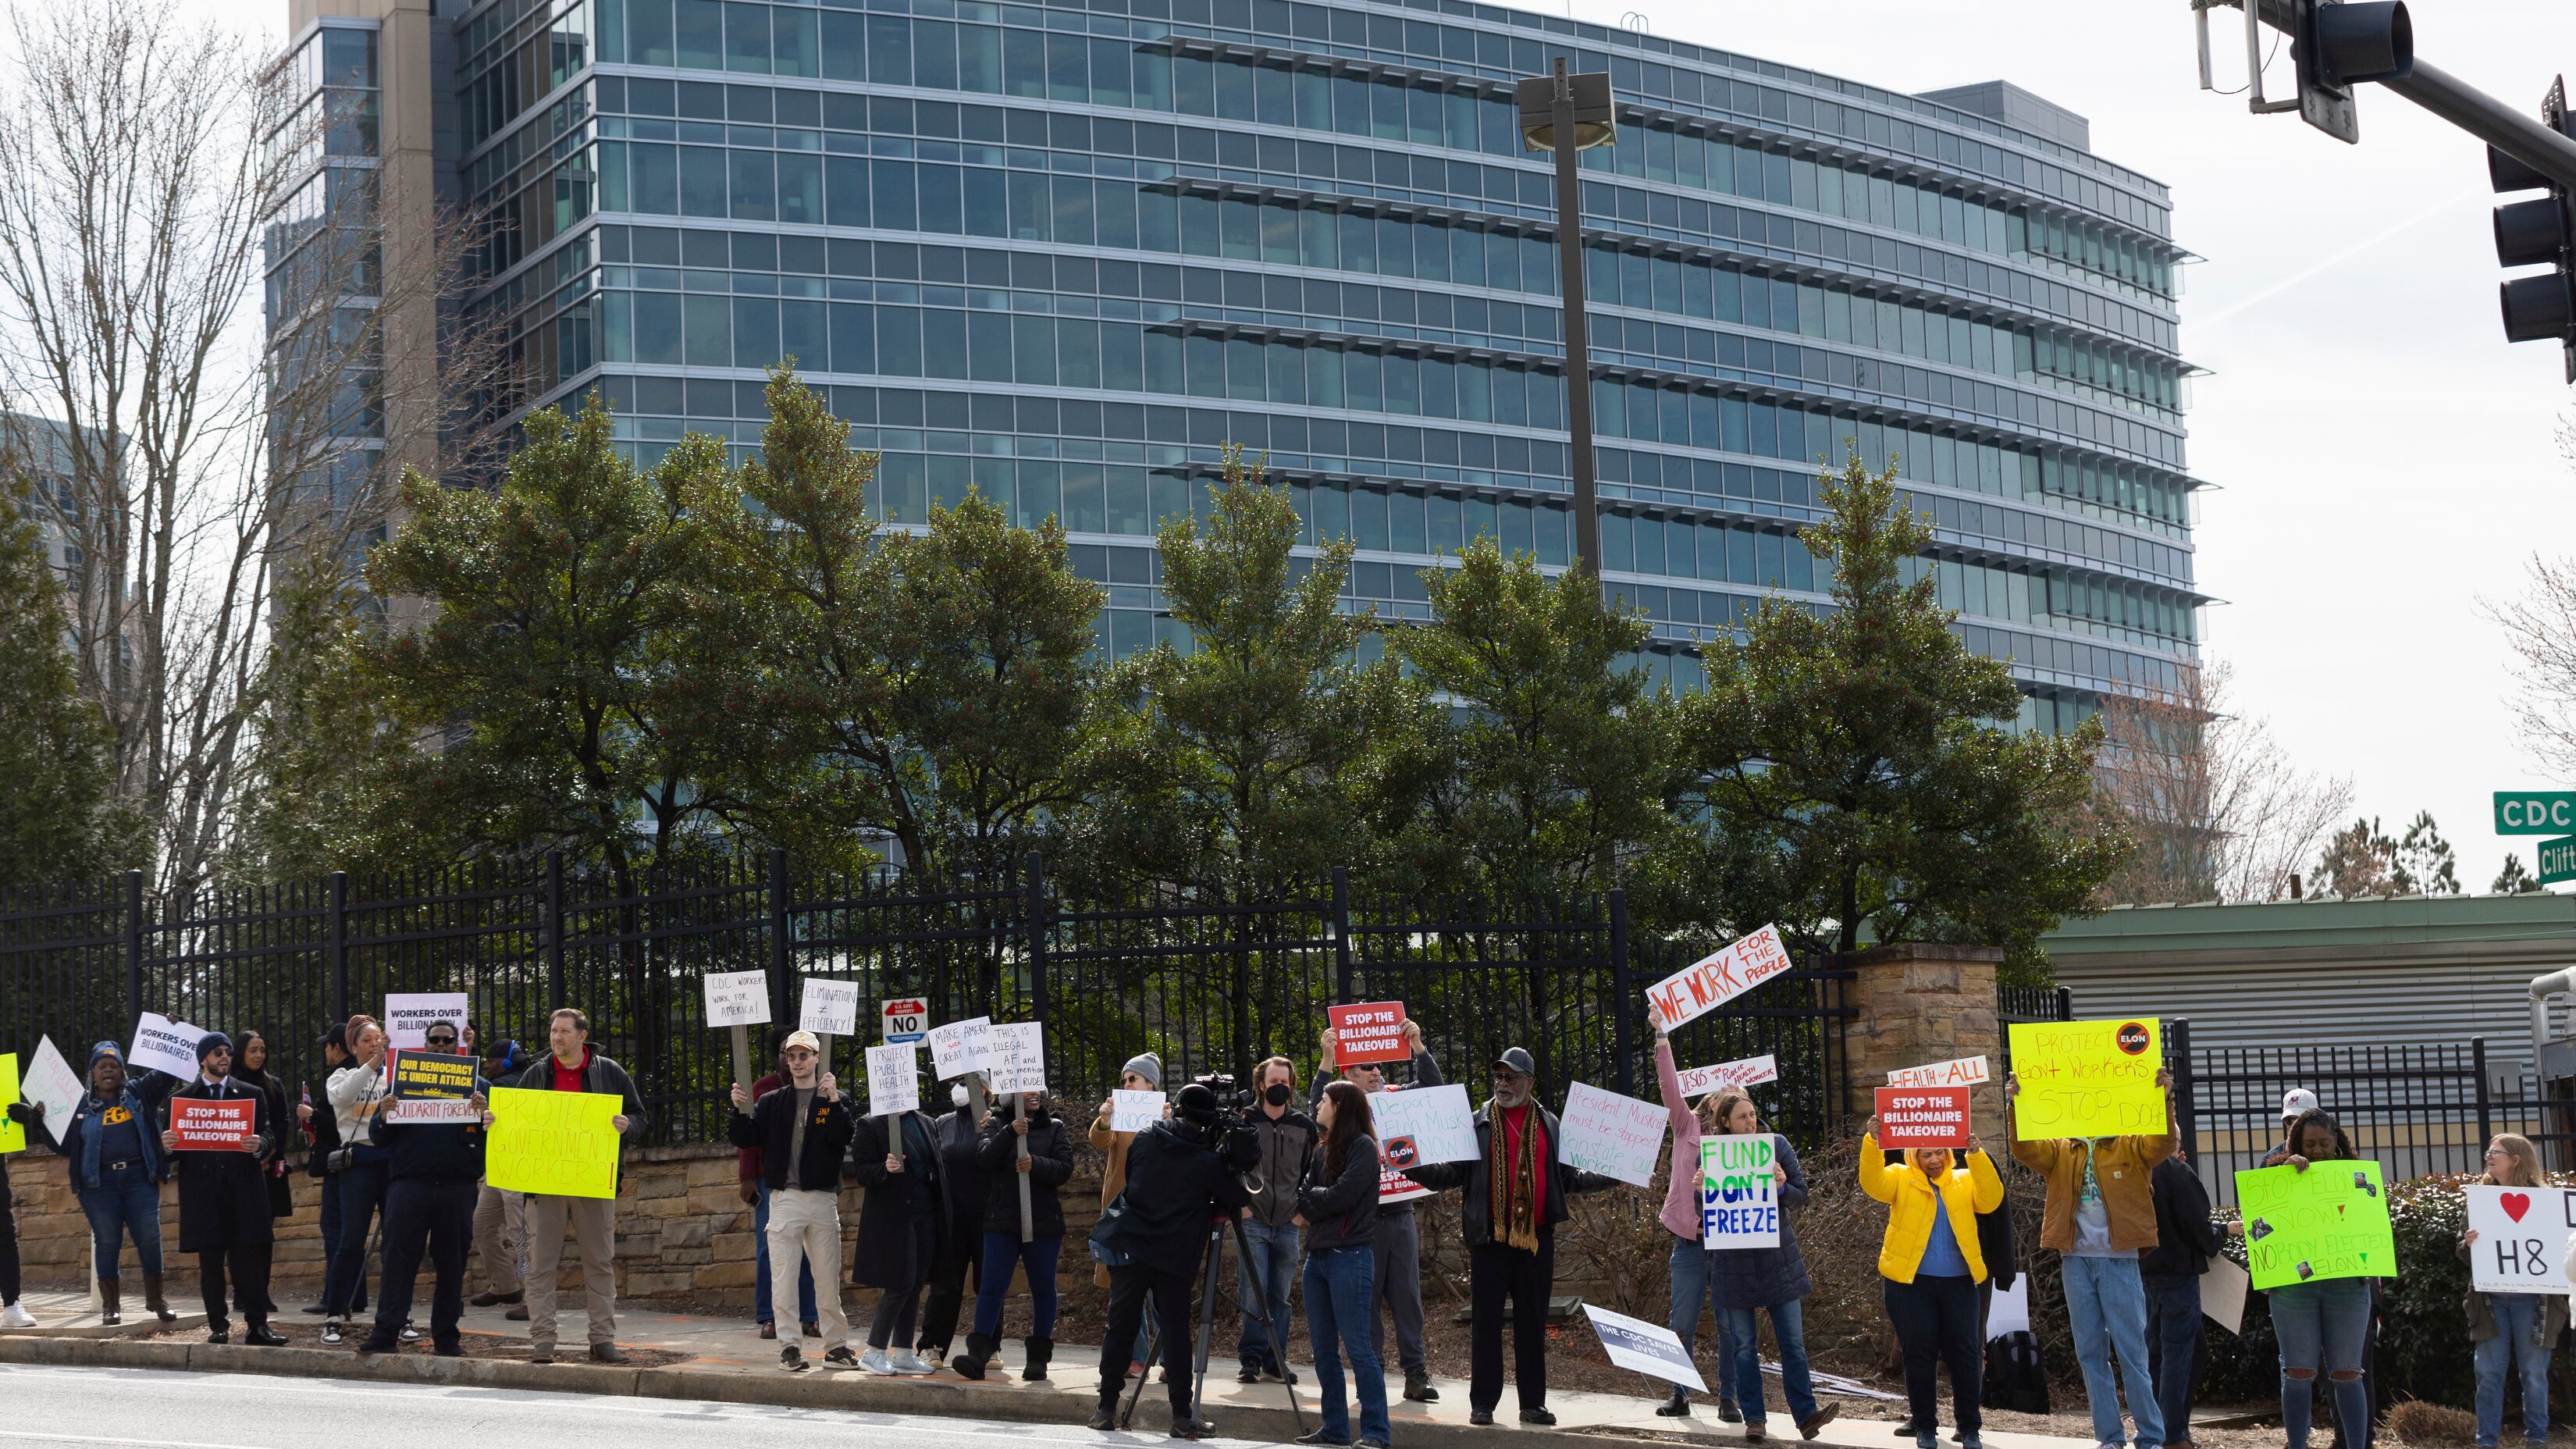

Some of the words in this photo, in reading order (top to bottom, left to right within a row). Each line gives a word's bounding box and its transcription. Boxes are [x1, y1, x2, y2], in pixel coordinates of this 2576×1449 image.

[2503, 799, 2571, 827] CDC
[2542, 845, 2576, 874] Clift
[1735, 930, 1774, 956] FOR
[1739, 944, 1776, 967] THE
[1745, 954, 1788, 984] PEOPLE
[712, 977, 731, 989] CDC
[738, 976, 766, 986] WORKERS
[1650, 980, 1692, 1024] WE
[1684, 956, 1742, 1009] WORK
[712, 995, 731, 1004] WORK
[735, 992, 749, 1002] FOR
[805, 985, 856, 1004] ELIMINATION
[391, 1009, 436, 1018] WORKERS
[437, 1009, 462, 1017] OVER
[721, 1001, 759, 1018] AMERICA!
[1345, 1013, 1372, 1025] STOP
[1374, 1011, 1394, 1023] THE
[802, 1016, 852, 1034] EFFICIENCY!
[893, 1016, 917, 1033] NO
[994, 1027, 1016, 1038] THIS
[1021, 1026, 1030, 1035] IS
[141, 1027, 180, 1044] WORKERS
[180, 1039, 197, 1051] OVE
[935, 1027, 959, 1045] MAKE
[964, 1023, 990, 1038] AMERIC
[2120, 1034, 2146, 1044] ELON
[141, 1038, 193, 1063] BILLIONAIRES!
[993, 1041, 1028, 1052] ILLEGAL
[1345, 1038, 1398, 1052] TAKEOVER
[2035, 1031, 2112, 1056] PROTECT
[875, 1045, 909, 1062] PROTECT
[938, 1049, 962, 1066] GREAT
[1004, 1053, 1018, 1066] AF
[1023, 1055, 1037, 1064] and
[400, 1059, 418, 1070] OUR
[419, 1061, 474, 1076] DEMOCRACY
[874, 1061, 909, 1077] PUBLIC
[993, 1068, 1004, 1077] not
[1016, 1066, 1044, 1074] mention
[1722, 1063, 1744, 1084] PUBLIC
[1735, 1066, 1756, 1084] HEALTH
[1745, 1068, 1774, 1084] WORKER
[1891, 1068, 1937, 1088] HEALTH
[1947, 1060, 1984, 1084] ALL
[398, 1071, 407, 1081] IS
[409, 1071, 438, 1084] UNDER
[439, 1075, 472, 1087] ATTACK
[878, 1074, 909, 1090] HEALTH
[998, 1077, 1018, 1091] VERY
[1023, 1074, 1044, 1089] RUDE!
[1678, 1070, 1707, 1094] JESUS
[883, 1099, 906, 1110] SUFFER
[1119, 1090, 1154, 1105] DUE
[1375, 1091, 1436, 1121] Deport
[1572, 1084, 1624, 1119] President
[1892, 1097, 1926, 1109] STOP
[1928, 1096, 1952, 1108] THE
[187, 1107, 216, 1117] STOP
[218, 1109, 240, 1119] THE
[388, 1102, 441, 1120] SOLIDARITY
[498, 1090, 622, 1133] PROTECT
[2030, 1089, 2112, 1125] STOP
[177, 1119, 247, 1130] BILLIONAIRE
[1425, 1107, 1469, 1132] Musk
[1884, 1111, 1962, 1123] BILLIONAIRE
[183, 1131, 241, 1141] TAKEOVER
[1568, 1112, 1594, 1130] must
[1598, 1118, 1612, 1135] be
[1615, 1122, 1660, 1150] stopped
[1890, 1125, 1956, 1137] TAKEOVER
[492, 1126, 616, 1161] GOVERNMENT
[1419, 1134, 1458, 1158] NOW
[1559, 1128, 1624, 1166] Reinstate
[1389, 1147, 1414, 1159] ELON
[1703, 1140, 1772, 1170] FUND
[495, 1155, 614, 1191] WORKERS!
[1570, 1151, 1624, 1179] Workers
[1704, 1171, 1774, 1204] DON'T
[2310, 1167, 2354, 1195] ELON
[1704, 1207, 1777, 1238] FREEZE
[2253, 1237, 2317, 1273] NOBODY
[2325, 1233, 2390, 1255] ELECTED
[2496, 1238, 2548, 1276] H8
[1599, 1324, 1619, 1337] THE
[1621, 1330, 1646, 1344] CDC
[1647, 1338, 1679, 1355] SAVES
[1632, 1342, 1660, 1357] LIVES
